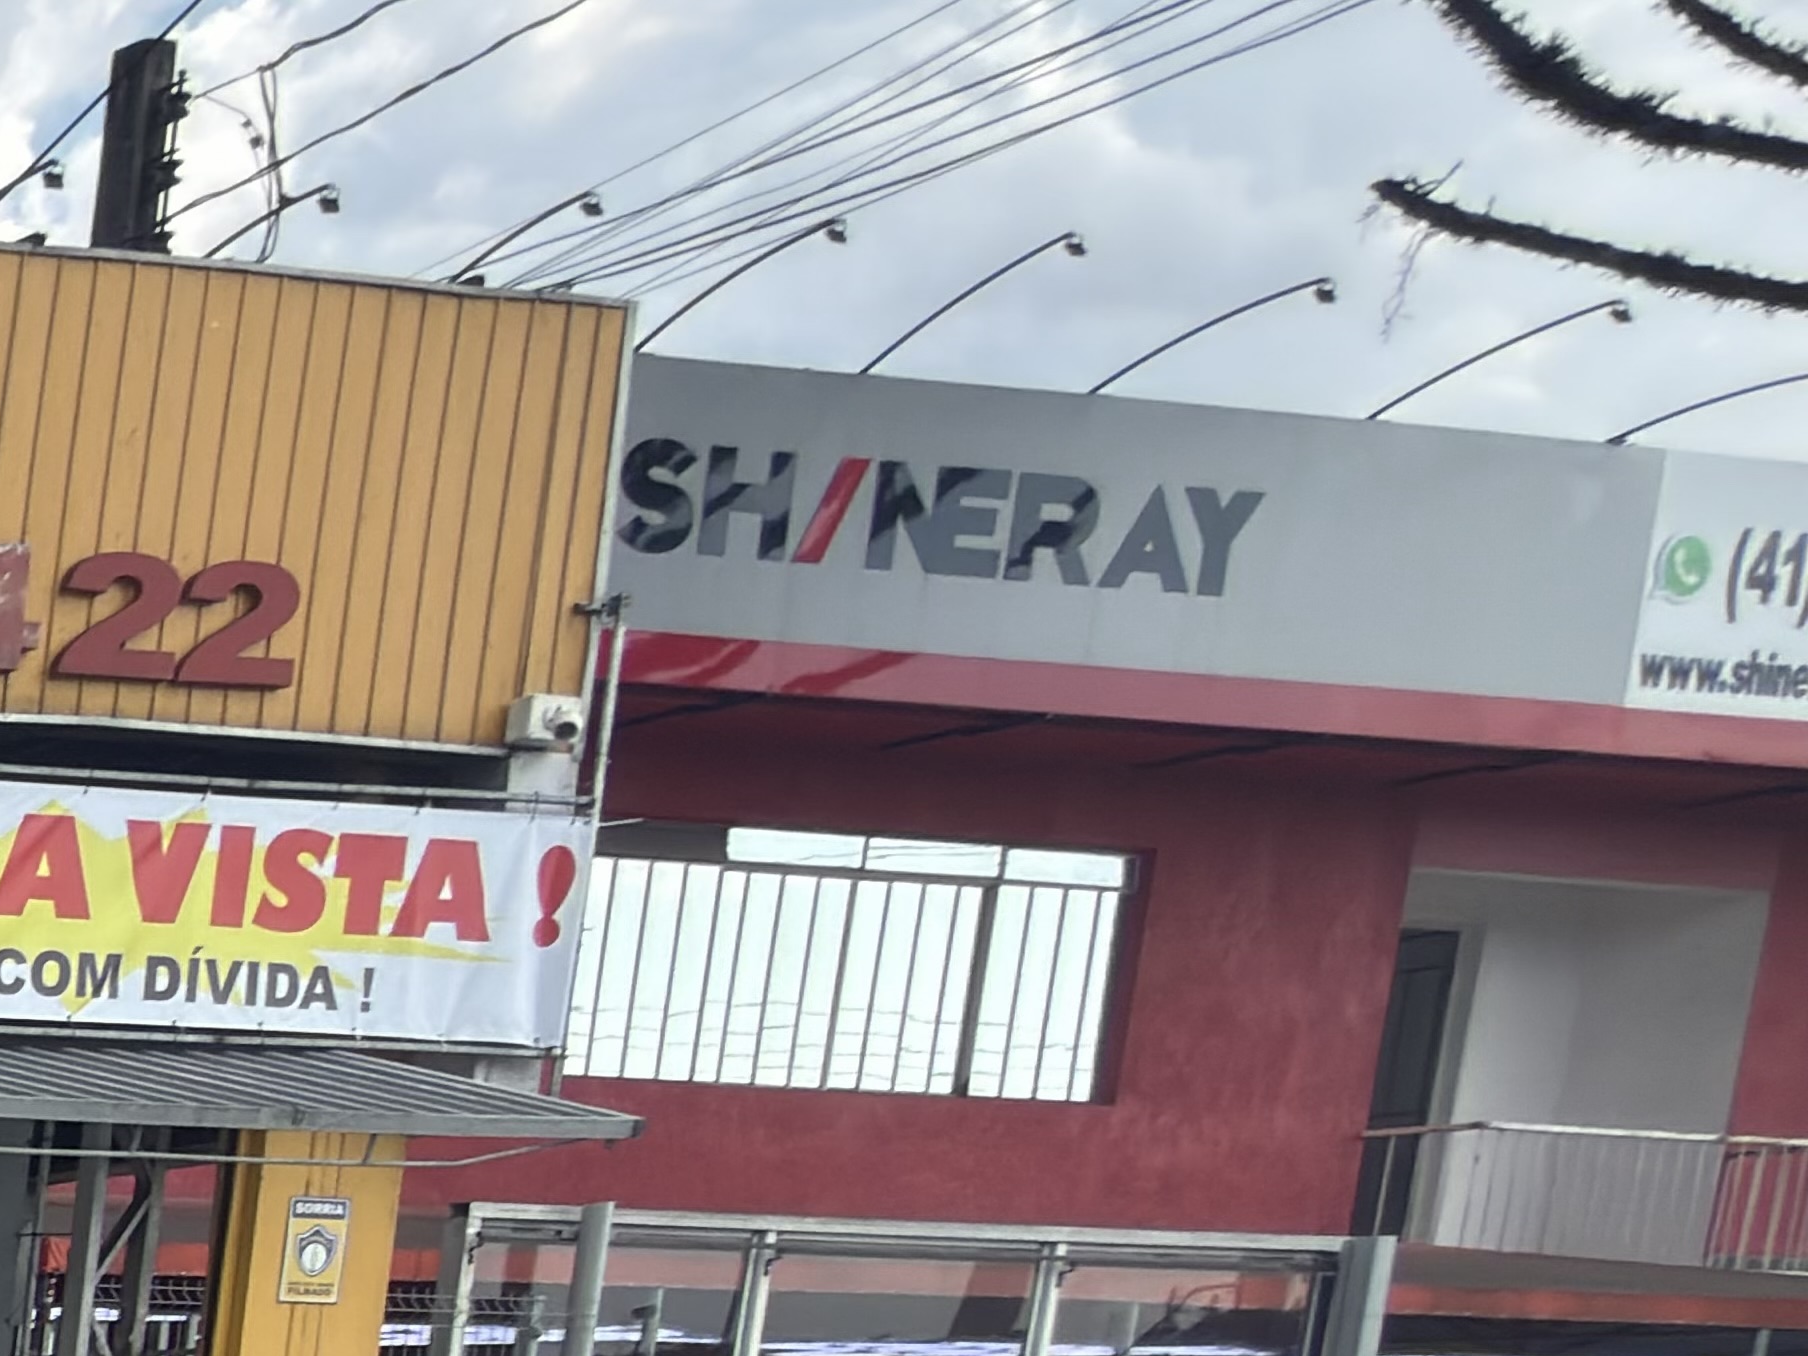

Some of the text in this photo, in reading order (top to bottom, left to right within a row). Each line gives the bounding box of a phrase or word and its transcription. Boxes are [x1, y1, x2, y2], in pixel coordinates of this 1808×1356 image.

[614, 437, 1268, 598] SHINERAY
[124, 820, 490, 945] VISTA
[532, 843, 576, 948] !
[141, 943, 338, 1012] DÍVIDA
